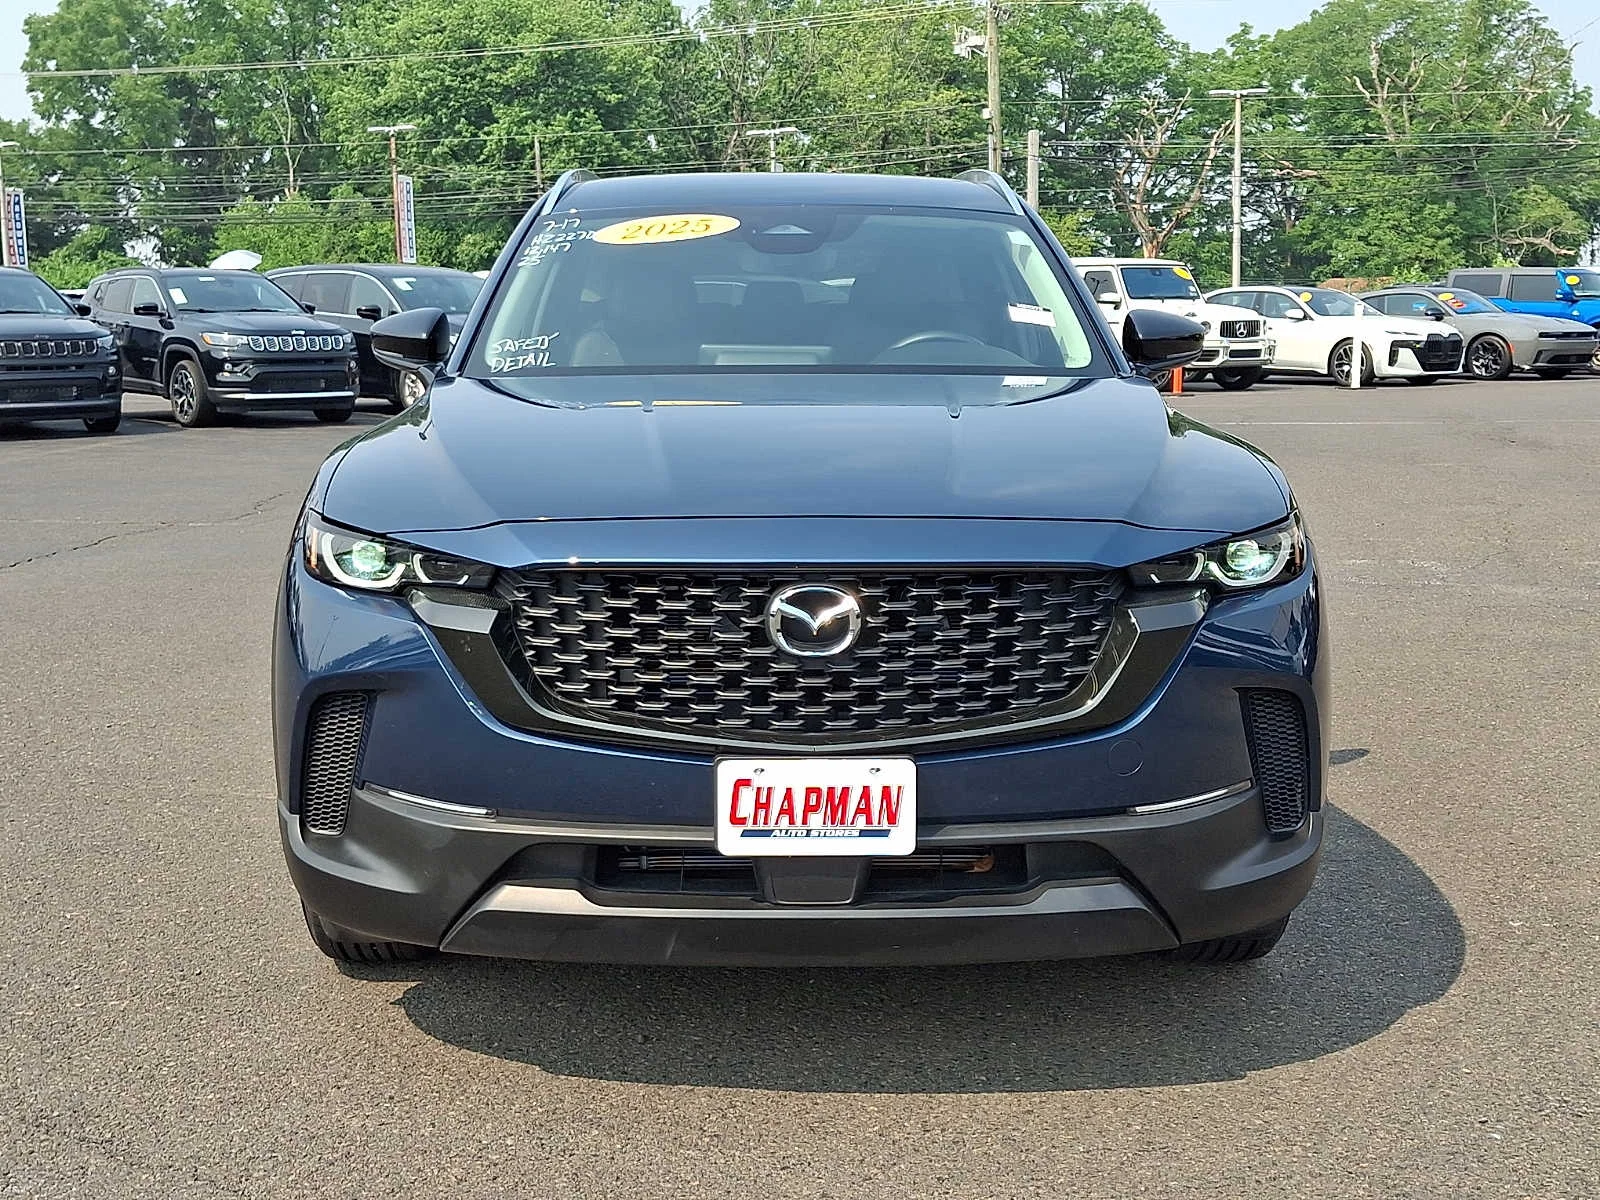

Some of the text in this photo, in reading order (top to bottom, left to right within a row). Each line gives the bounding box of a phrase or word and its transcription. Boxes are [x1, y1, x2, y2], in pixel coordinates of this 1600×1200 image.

[543, 219, 580, 231] 7-17
[622, 219, 712, 239] 2025
[491, 352, 556, 372] DETAIL
[771, 829, 861, 838] AUTO STORES
